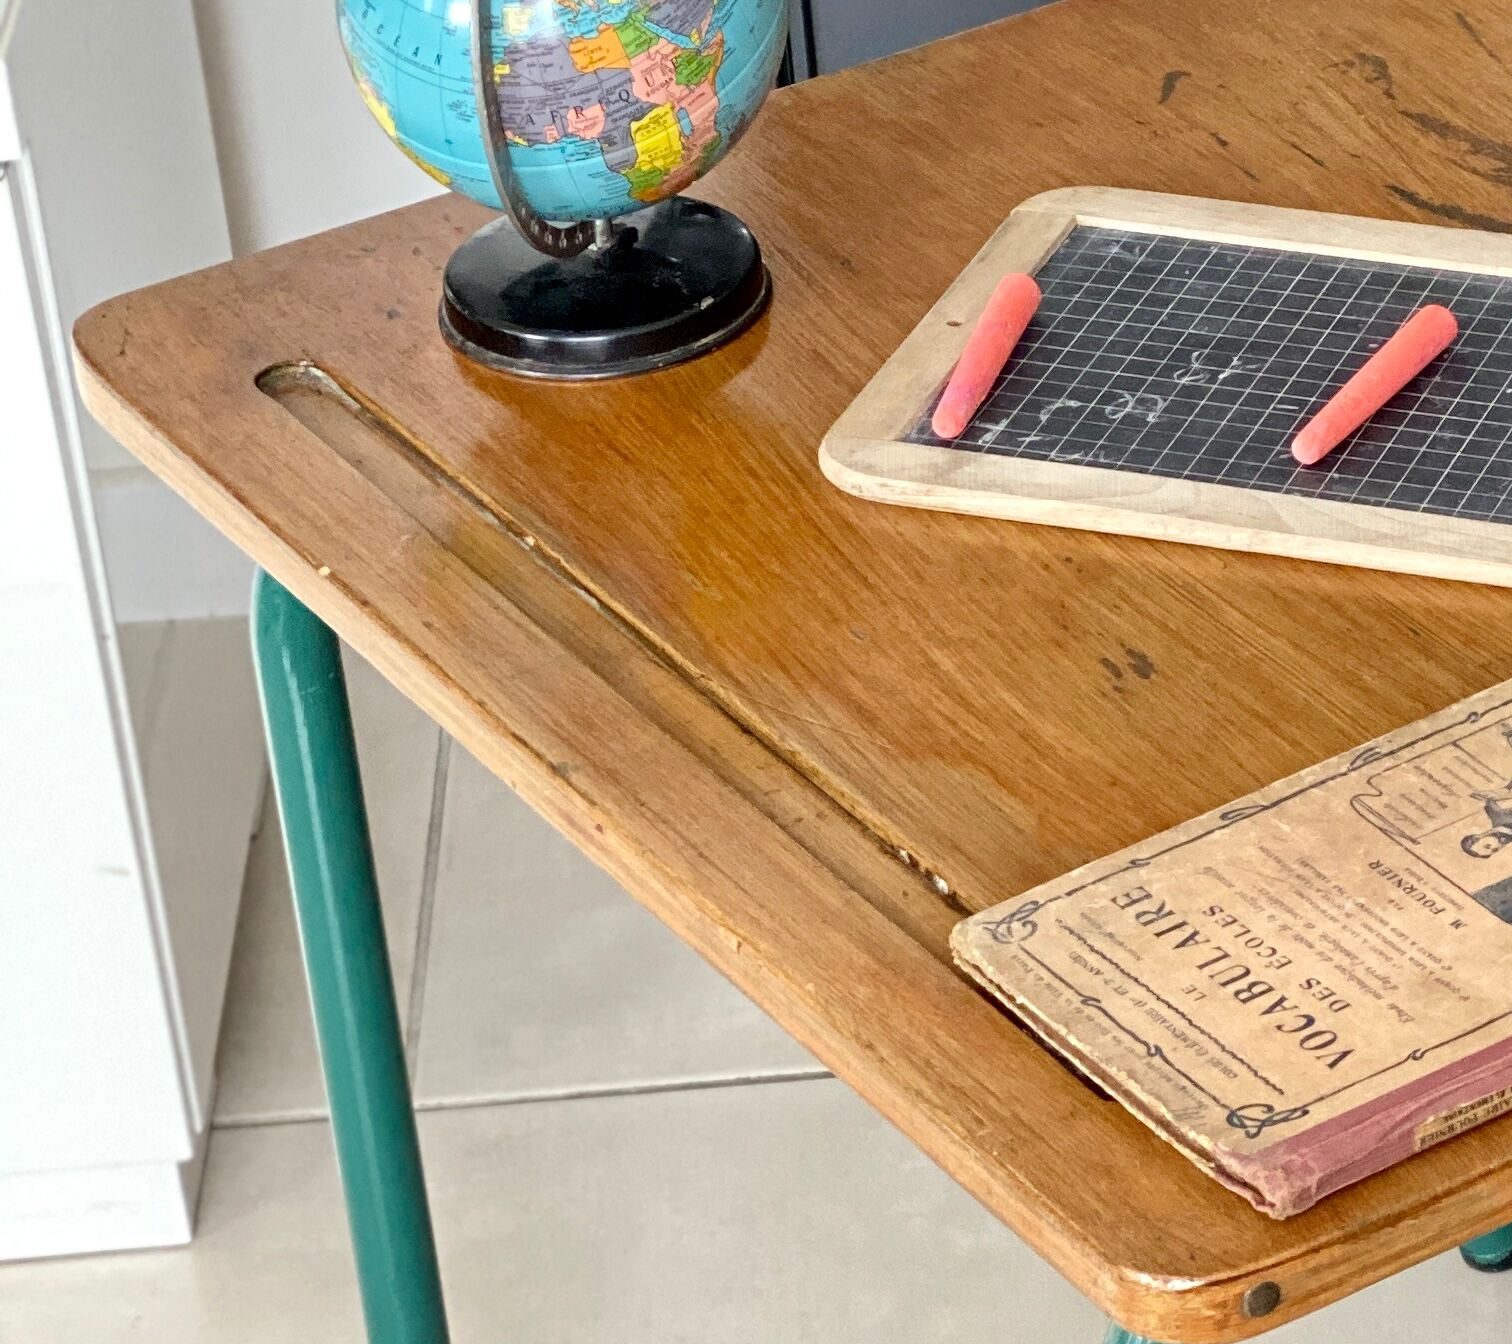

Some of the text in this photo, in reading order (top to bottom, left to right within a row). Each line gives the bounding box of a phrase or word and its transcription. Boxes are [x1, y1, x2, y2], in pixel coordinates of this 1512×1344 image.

[1366, 858, 1446, 915] FOURNIER
[1200, 903, 1294, 970] ÉCOLES
[1108, 884, 1356, 1071] VOCABULAIRE
[1180, 983, 1208, 1002] LE
[1297, 976, 1352, 1014] DES
[1142, 1006, 1209, 1057] ÉLÉMENTAIRE
[1205, 1056, 1239, 1080] COURS
[1419, 1112, 1480, 1148] FOURNIER
